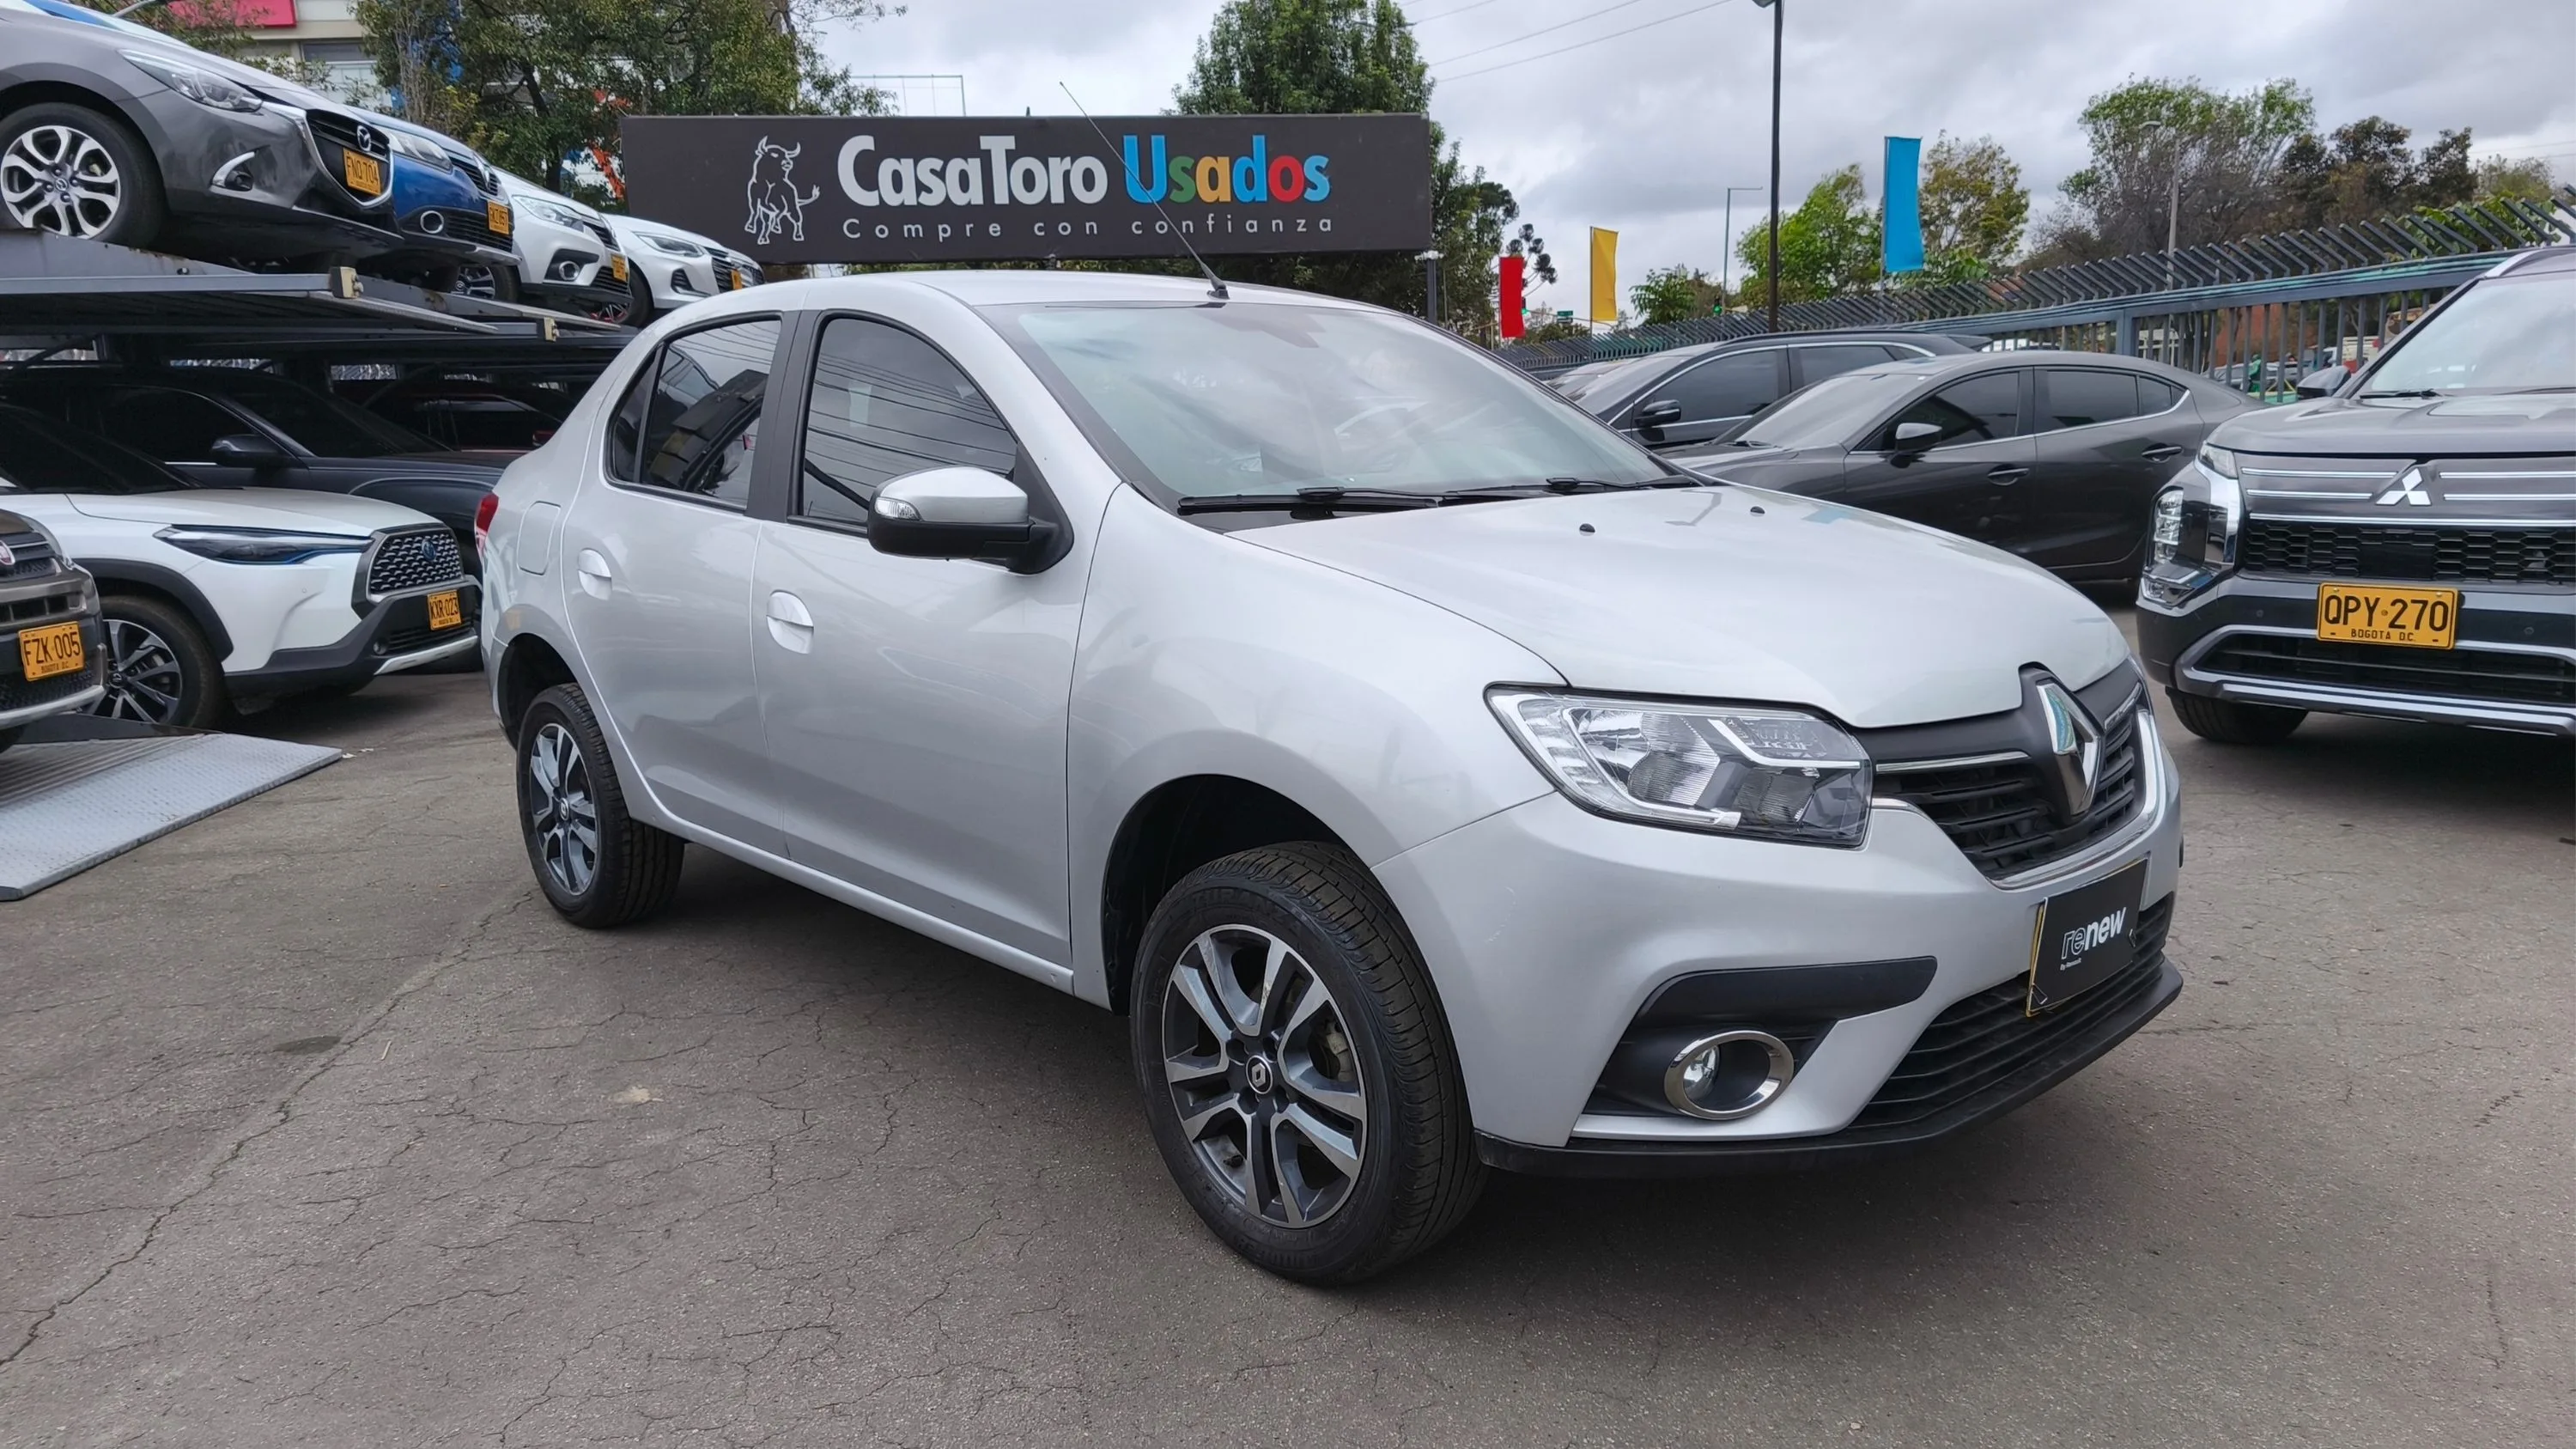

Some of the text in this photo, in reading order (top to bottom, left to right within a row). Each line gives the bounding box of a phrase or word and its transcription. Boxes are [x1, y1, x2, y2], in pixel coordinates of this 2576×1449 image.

[1123, 135, 1330, 204] Usados
[842, 213, 1332, 242] Compre con confianza
[430, 597, 459, 619] KXR 023
[2324, 594, 2449, 632] QPY 270
[23, 631, 81, 666] FZK 005
[2350, 628, 2391, 640] BOGOTA
[2061, 906, 2126, 959] renew
